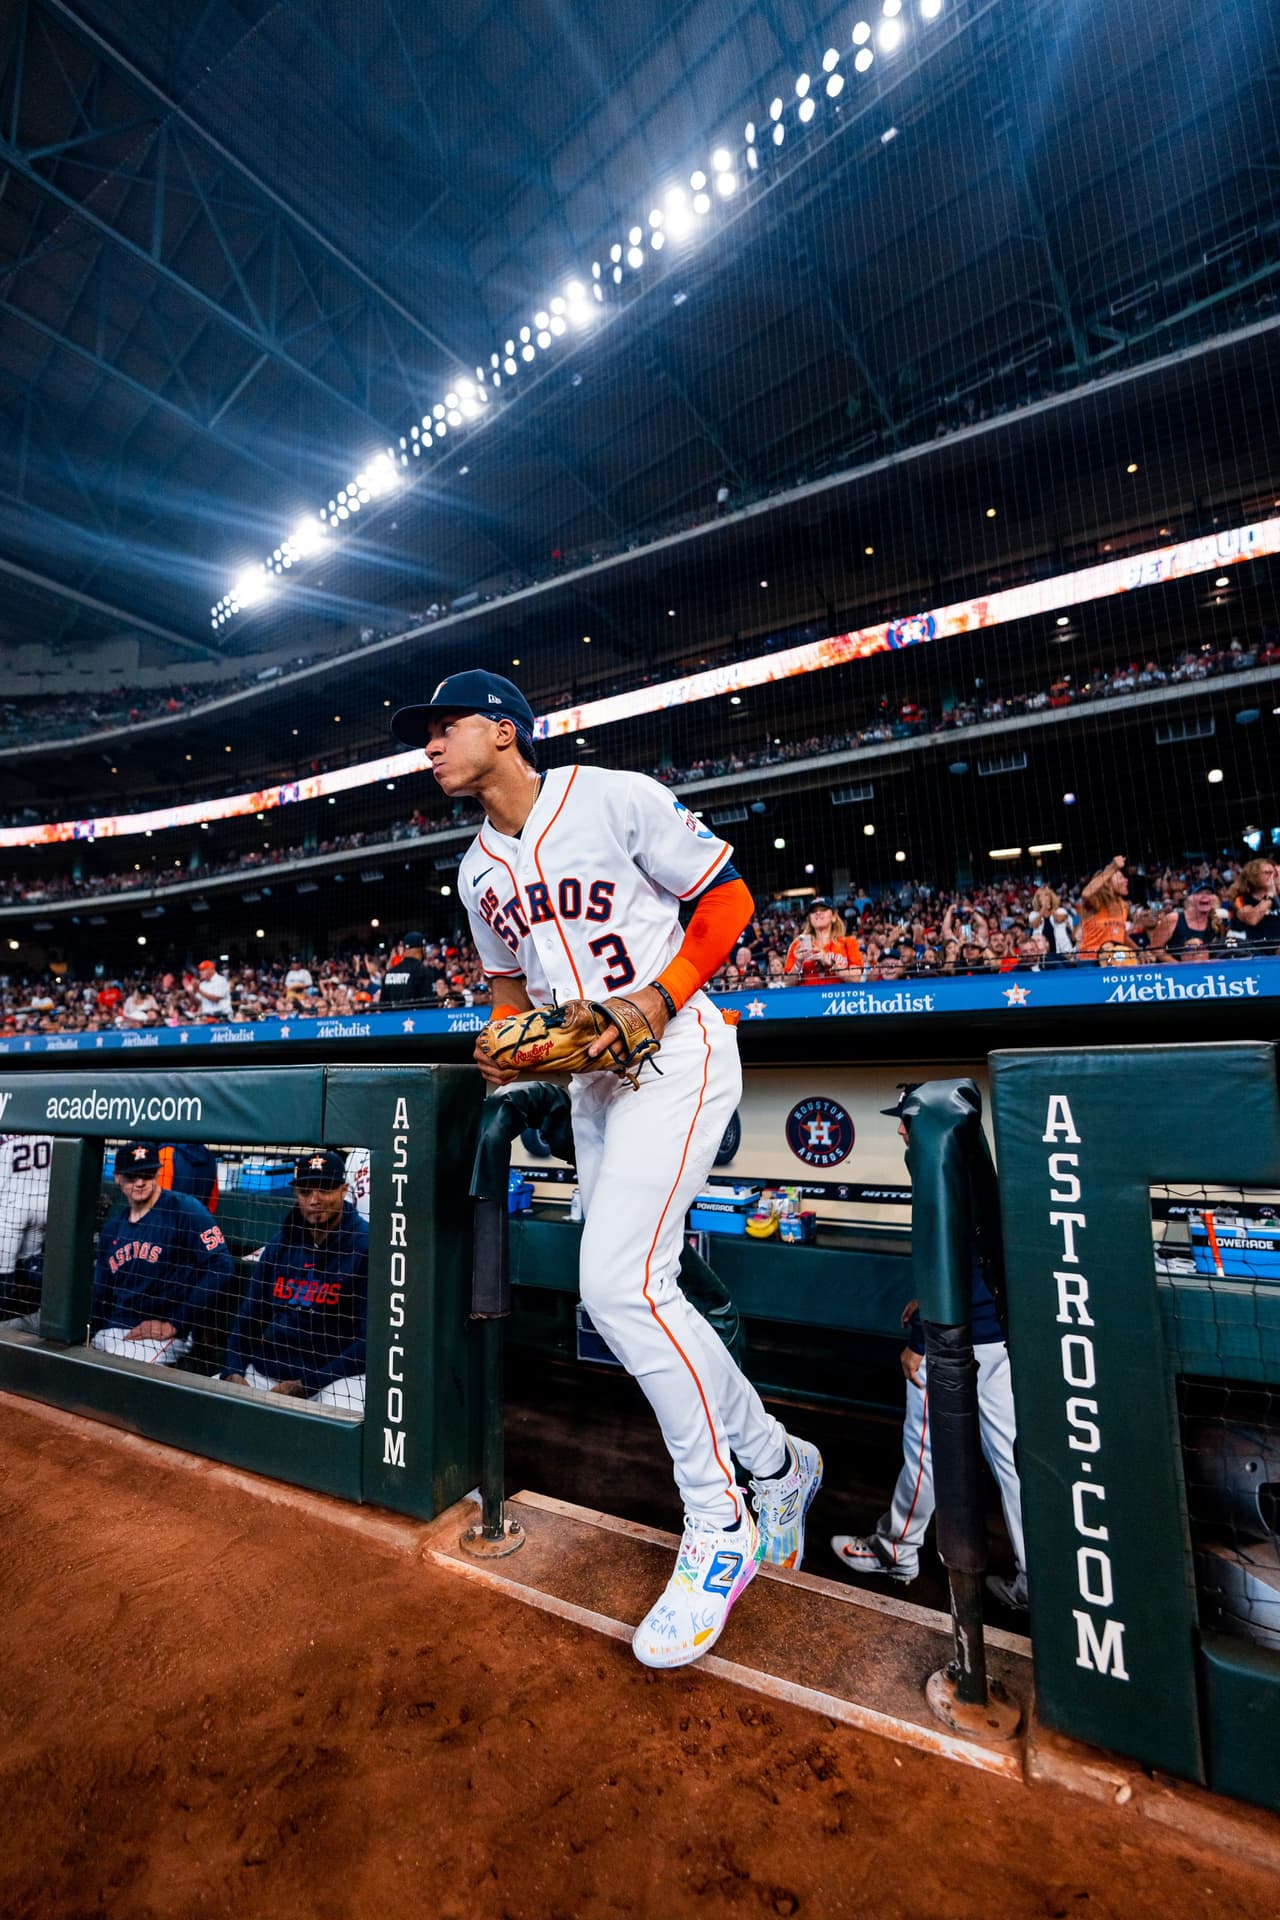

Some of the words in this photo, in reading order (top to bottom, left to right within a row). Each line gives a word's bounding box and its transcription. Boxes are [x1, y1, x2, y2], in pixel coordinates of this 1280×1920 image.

[480, 887, 499, 927] LOS
[491, 878, 616, 957] STROS
[588, 933, 636, 992] 3
[1102, 973, 1162, 983] HOUSTON
[1105, 976, 1260, 1003] Methodist
[821, 990, 865, 999] HOUSTON
[822, 993, 934, 1016] Methodist
[210, 1029, 255, 1043] Methodist
[316, 1022, 371, 1038] Methodist
[514, 1040, 555, 1065] Rawlings
[46, 1089, 202, 1127] academy.com
[793, 1100, 845, 1120] HOUSTON
[13, 1141, 51, 1173] 20
[797, 1146, 844, 1164] ASTROS
[861, 1190, 912, 1199] NITTO
[696, 1202, 735, 1213] POWERADE
[1208, 1238, 1275, 1250] OWERADE
[108, 1241, 162, 1273] ASTROS
[272, 1276, 342, 1305] ASTROS
